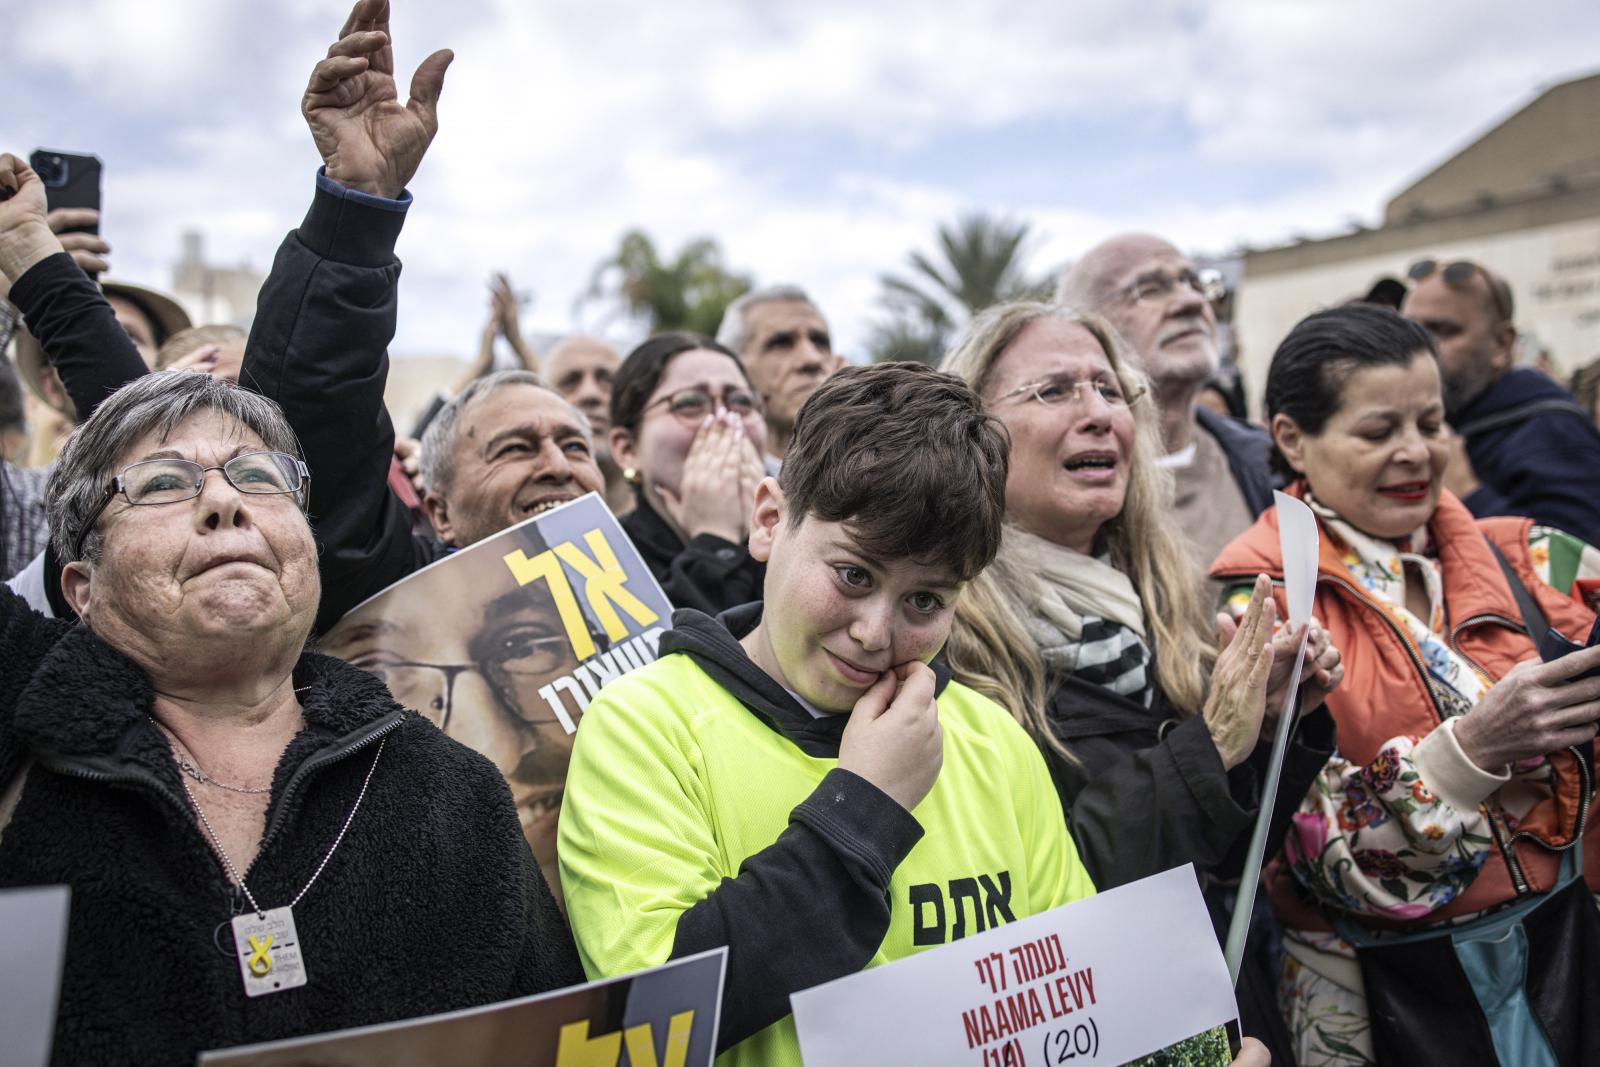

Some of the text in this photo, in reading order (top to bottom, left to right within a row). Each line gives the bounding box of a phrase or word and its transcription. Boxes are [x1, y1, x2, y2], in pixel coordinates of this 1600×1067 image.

[503, 528, 659, 661] אל
[909, 870, 1017, 946] אתם
[974, 933, 1066, 994] נעמה לוי
[962, 967, 1096, 1049] NAAMA LEVY
[1043, 1017, 1099, 1067] (20)
